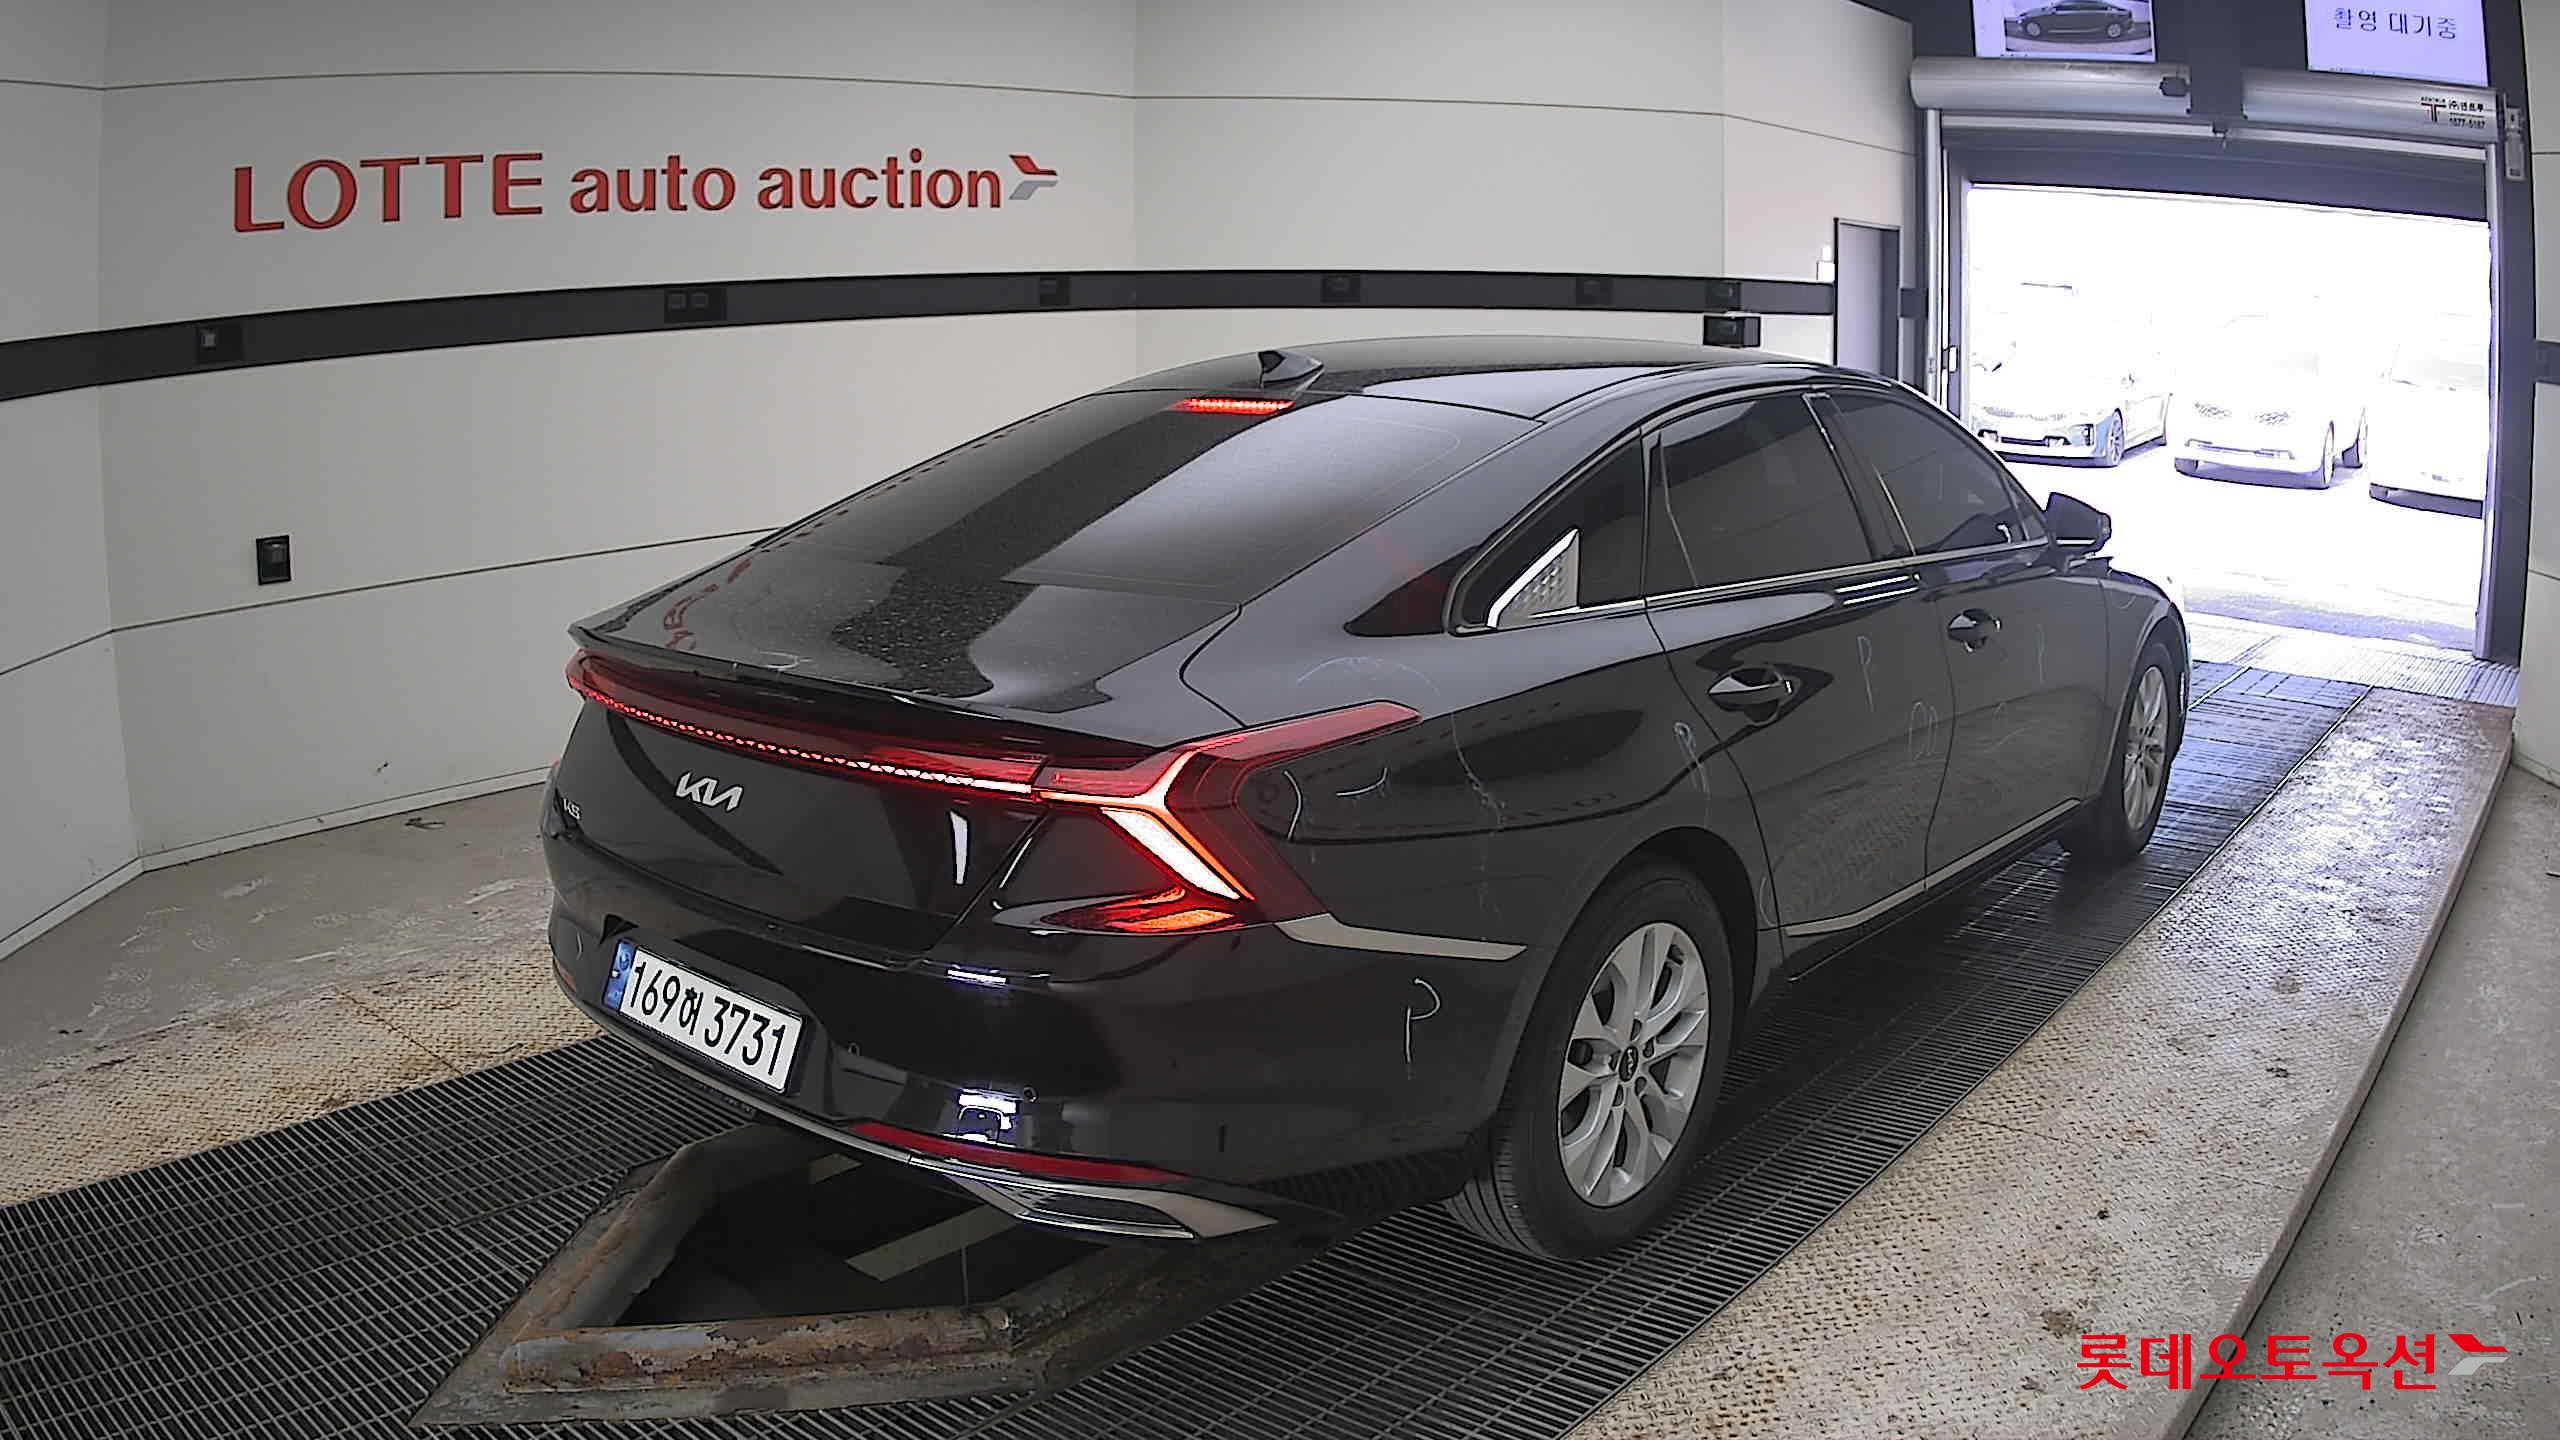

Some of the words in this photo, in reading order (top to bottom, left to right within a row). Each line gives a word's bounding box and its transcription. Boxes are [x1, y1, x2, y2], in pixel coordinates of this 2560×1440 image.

[2389, 12, 2457, 40] 대기중
[233, 152, 543, 233] LOTTE
[569, 154, 737, 213] auto
[757, 148, 1003, 210] auction
[674, 770, 745, 813] KIA
[629, 960, 704, 1036] 169허
[704, 995, 787, 1077] 3731
